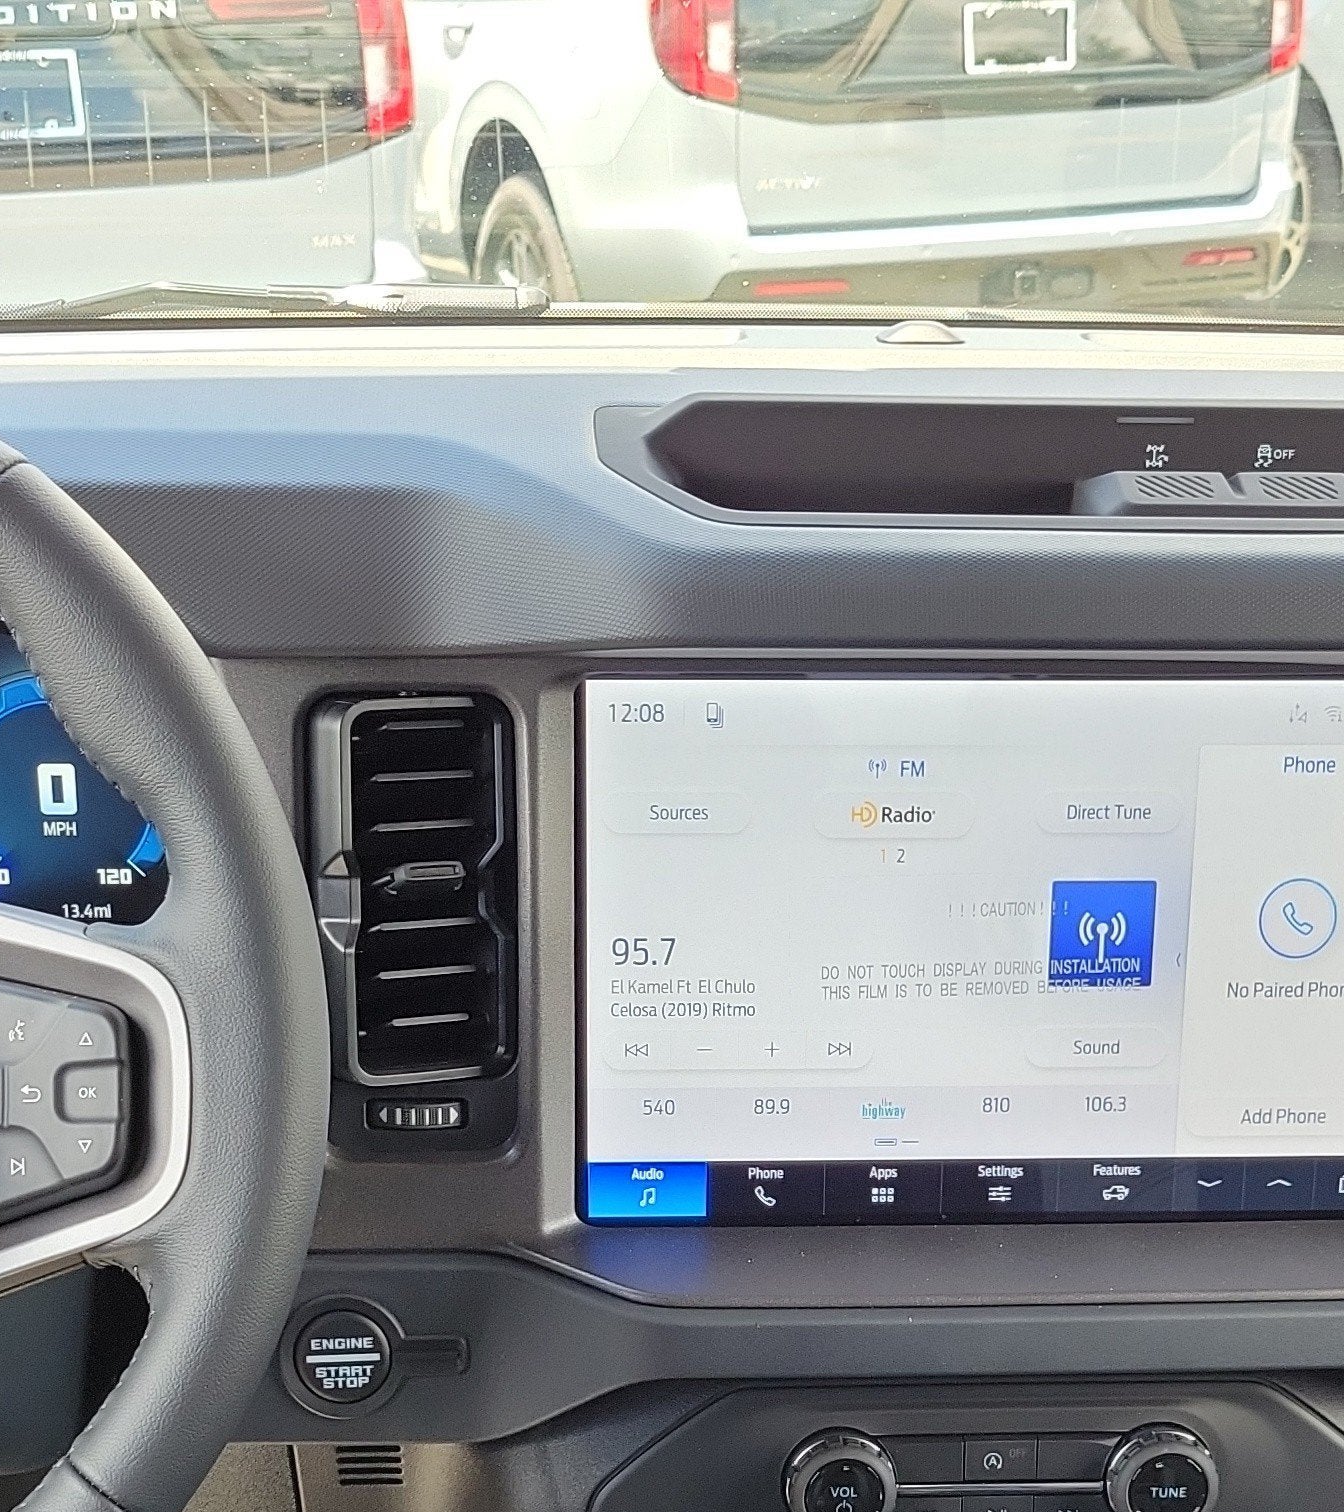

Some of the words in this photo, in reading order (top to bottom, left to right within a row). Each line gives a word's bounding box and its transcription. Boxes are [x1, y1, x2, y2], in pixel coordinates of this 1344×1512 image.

[1273, 449, 1296, 460] OFF
[608, 703, 665, 723] 12:08
[900, 760, 926, 778] FM
[1283, 756, 1337, 775] Phone
[37, 763, 78, 815] 0
[649, 804, 709, 821] Sources
[1067, 804, 1110, 821] Direct
[1114, 804, 1152, 821] Tune
[43, 822, 77, 837] MPH
[896, 848, 906, 864] 2
[96, 868, 133, 885] 120
[611, 937, 676, 966] 95.7
[821, 966, 839, 980] DO
[848, 965, 874, 980] NOT
[881, 963, 925, 979] TOUCH
[934, 962, 986, 977] DISPLAY
[994, 961, 1043, 975] DURING
[1050, 958, 1141, 974] INSTALLATION
[611, 980, 625, 995] El
[627, 979, 674, 995] Kamel
[698, 980, 712, 995] El
[714, 979, 756, 995] Chulo
[822, 986, 851, 1000] THIS
[859, 985, 887, 999] FILM
[896, 984, 907, 998] IS
[915, 984, 932, 997] TO
[940, 983, 957, 997] BE
[966, 981, 1029, 996] REMOVED
[1038, 978, 1089, 994] BEFORE
[1097, 977, 1142, 992] USAGE
[1226, 982, 1249, 998] No
[1253, 982, 1305, 998] Paired
[610, 1002, 658, 1018] Celosa
[661, 1002, 709, 1020] (2019)
[712, 1002, 756, 1018] Ritmo
[1073, 1040, 1120, 1056] Sound
[78, 1087, 97, 1099] OK
[643, 1100, 675, 1116] 540
[753, 1098, 790, 1116] 89.9
[862, 1105, 906, 1120] highway
[982, 1097, 1010, 1114] 810
[1084, 1096, 1127, 1113] 106.3
[1240, 1109, 1273, 1125] Add
[1275, 1108, 1327, 1125] Phone
[631, 1167, 664, 1181] Audio
[748, 1167, 785, 1180] Phone
[869, 1167, 898, 1183] Apps
[977, 1165, 1024, 1181] Settings
[1093, 1164, 1142, 1177] Features
[310, 1337, 374, 1351] ENGINE
[315, 1365, 375, 1378] START
[323, 1376, 370, 1389] STOP
[830, 1486, 858, 1498] VOL
[1150, 1487, 1187, 1499] TUNE
